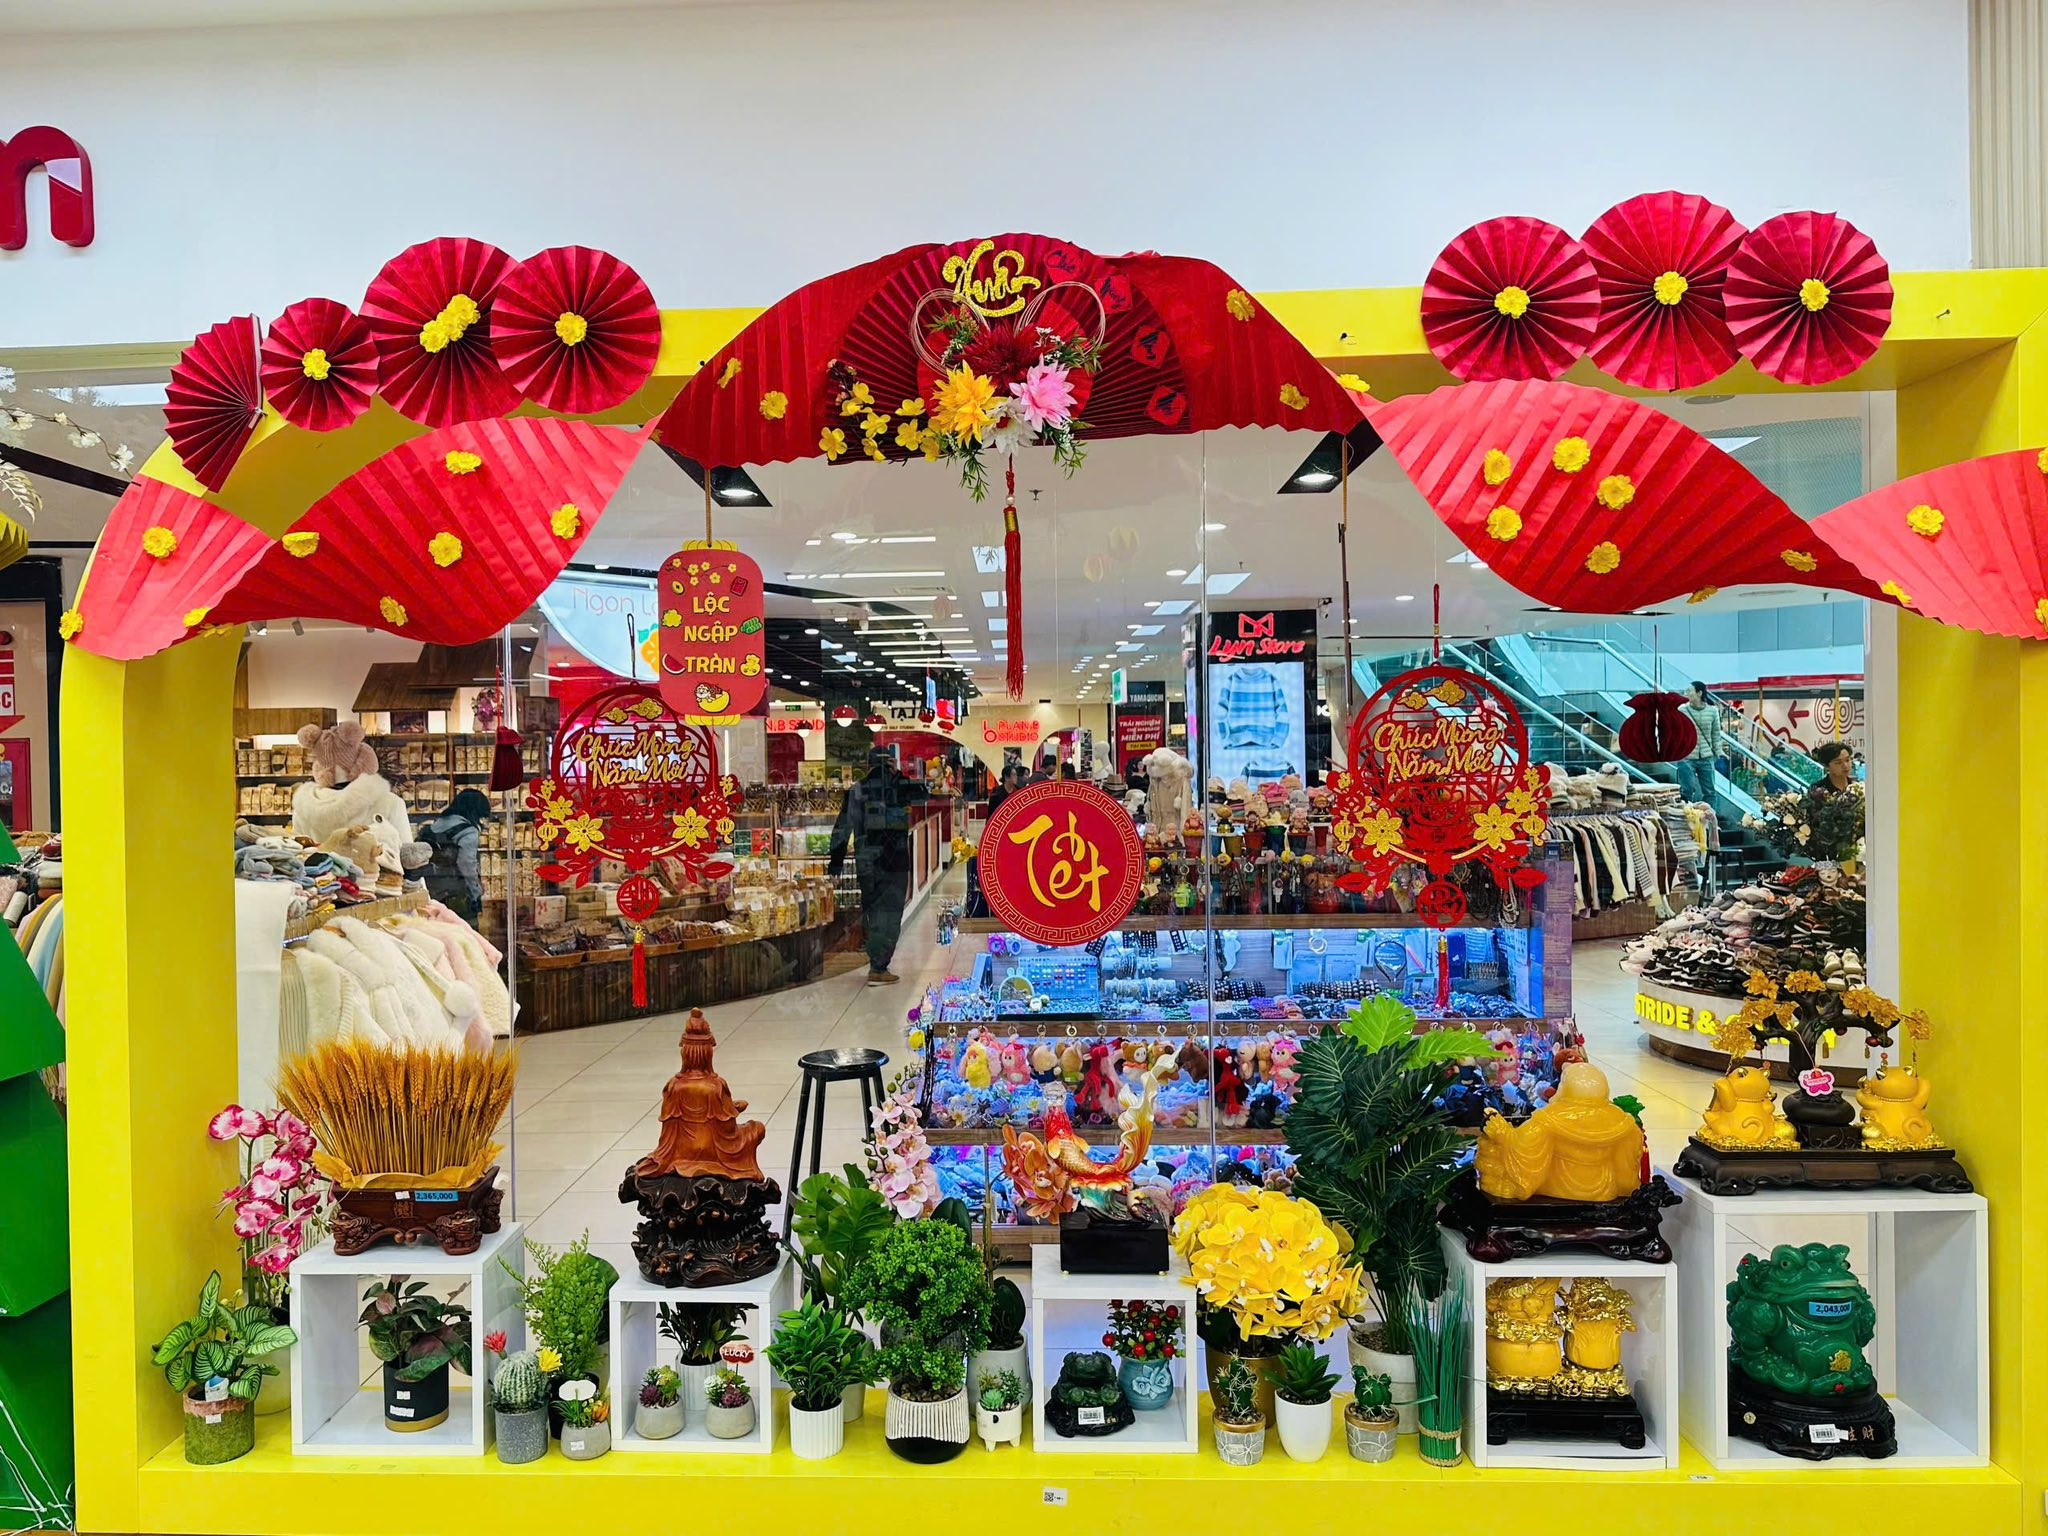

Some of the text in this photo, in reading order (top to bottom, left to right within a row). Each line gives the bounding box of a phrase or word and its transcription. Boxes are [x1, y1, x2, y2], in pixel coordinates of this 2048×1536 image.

[572, 587, 634, 615] Ngon
[692, 592, 730, 615] LỘC
[684, 620, 738, 643] NGẬP
[1208, 635, 1305, 662] Lyn Store
[685, 653, 736, 673] TRÀN
[1130, 694, 1164, 702] YAMAGUCHI
[576, 731, 694, 761] Chúc Mừng
[1374, 717, 1501, 752] Chúc Mừng
[589, 757, 688, 789] Năm Mới
[1387, 745, 1493, 784] Năm Mới
[1007, 811, 1110, 913] Tết
[1634, 992, 1693, 1031] STRIDE
[1696, 1009, 1717, 1035] &
[415, 1192, 454, 1200] 2,365,000
[1815, 1304, 1850, 1314] 2,043,000
[723, 1347, 750, 1358] LUCKY
